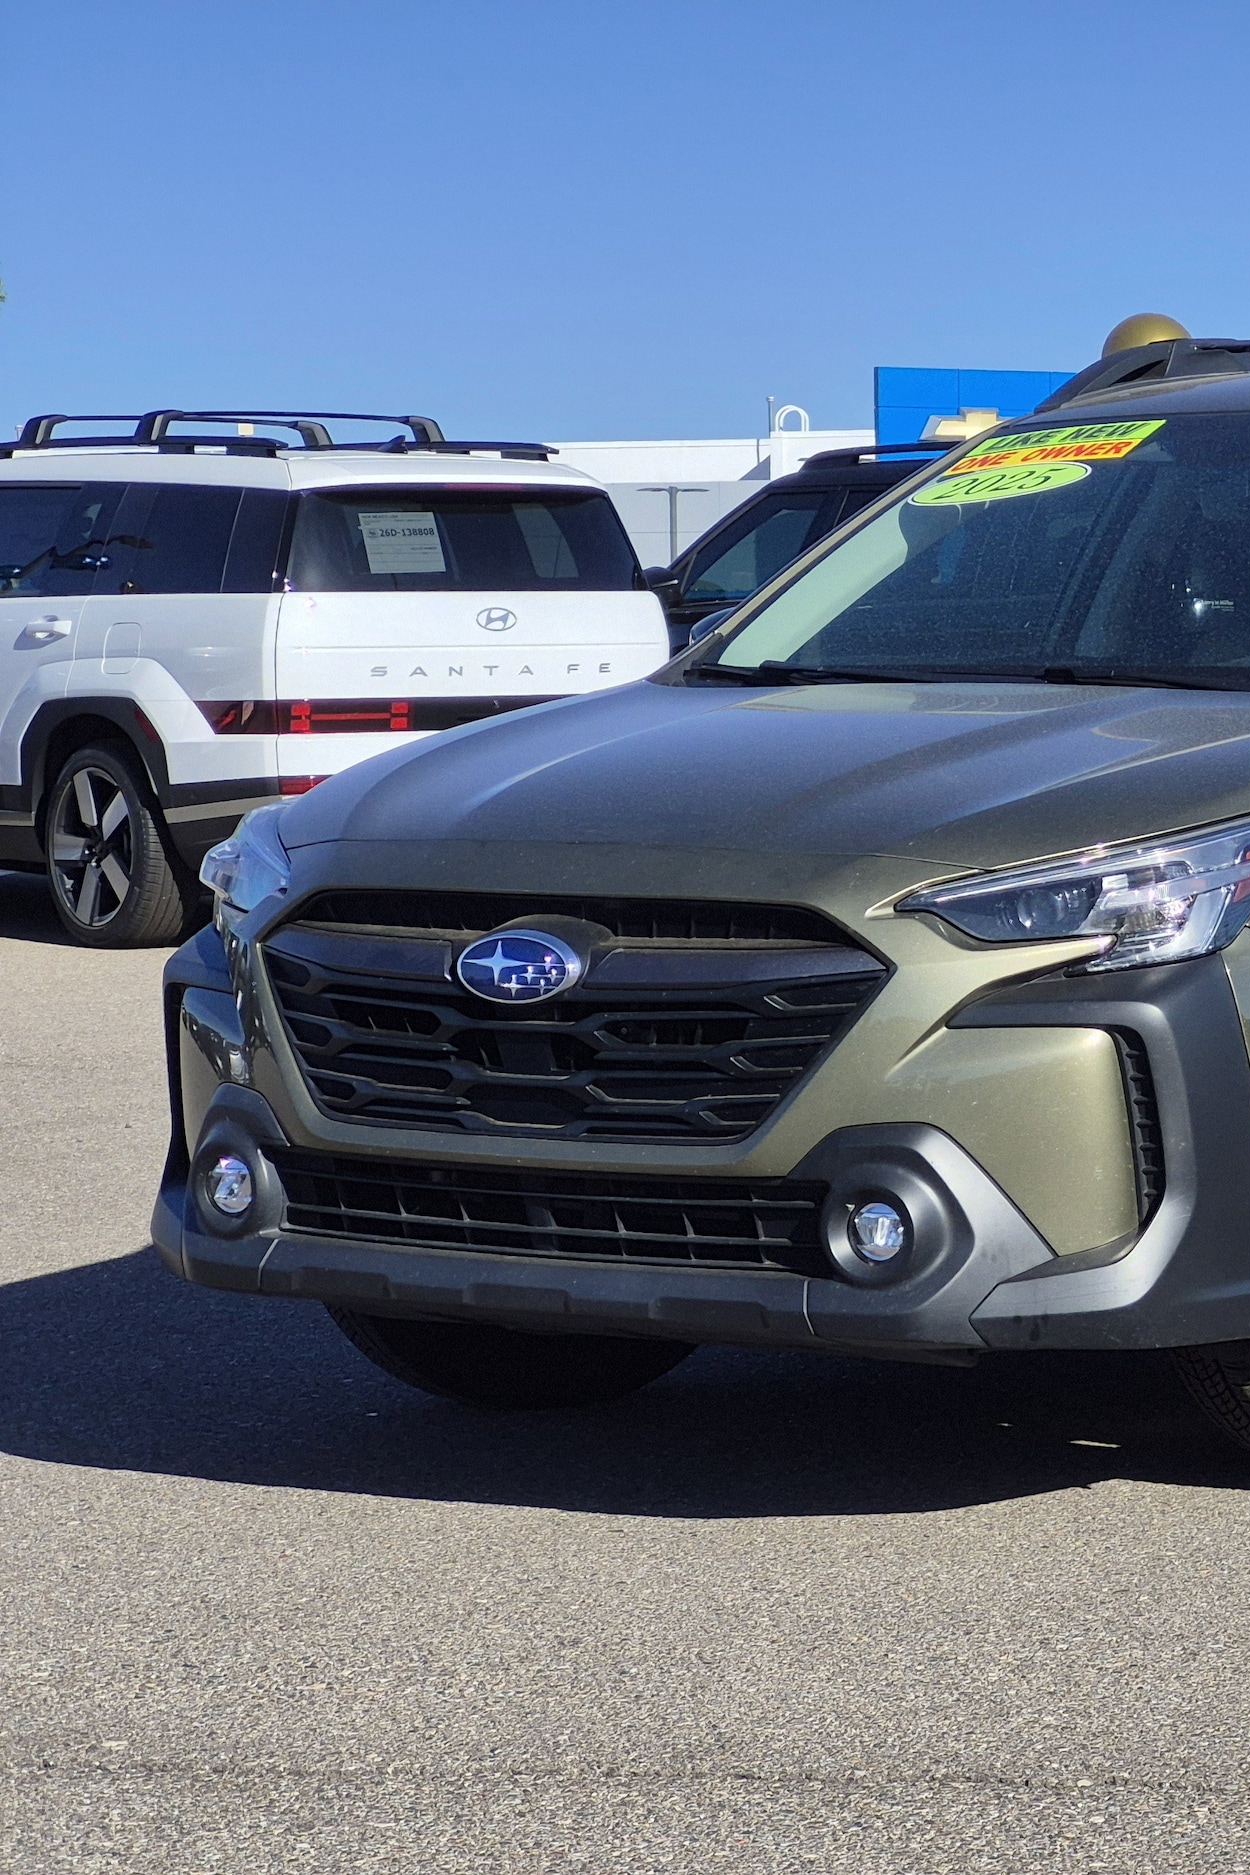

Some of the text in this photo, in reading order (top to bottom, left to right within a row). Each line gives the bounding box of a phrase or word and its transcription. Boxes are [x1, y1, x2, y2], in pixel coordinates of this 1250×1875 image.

[990, 423, 1147, 450] LIKE NEW
[951, 442, 1131, 472] ONE OWNER
[933, 468, 1068, 500] 2025
[380, 527, 435, 537] 26D-138808
[370, 662, 611, 678] SANTA FE
